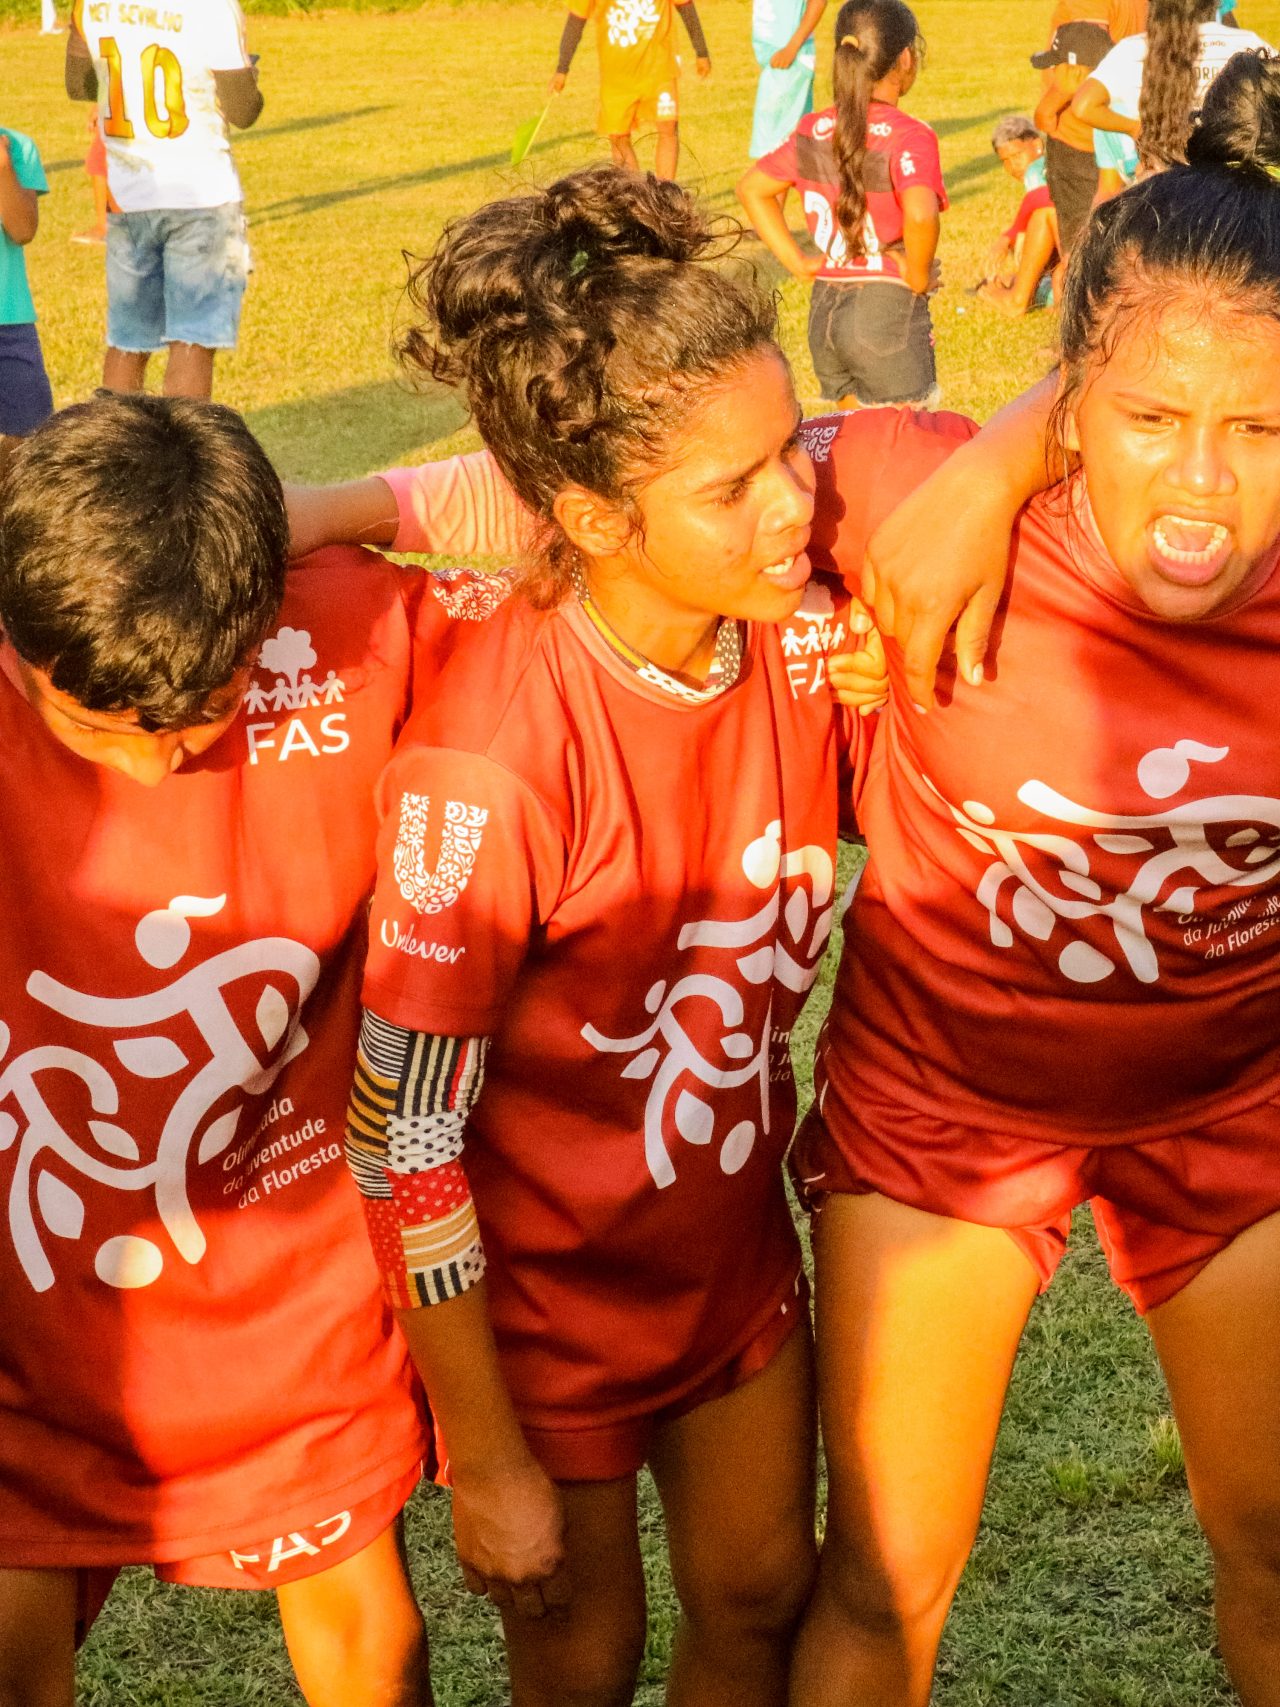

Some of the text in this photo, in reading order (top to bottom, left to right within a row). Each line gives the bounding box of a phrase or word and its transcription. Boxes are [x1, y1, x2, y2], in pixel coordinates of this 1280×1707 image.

[98, 36, 190, 139] 10
[786, 657, 826, 701] FA
[246, 712, 351, 766] FAS
[1183, 928, 1202, 946] da
[238, 1143, 341, 1209] da Floresta
